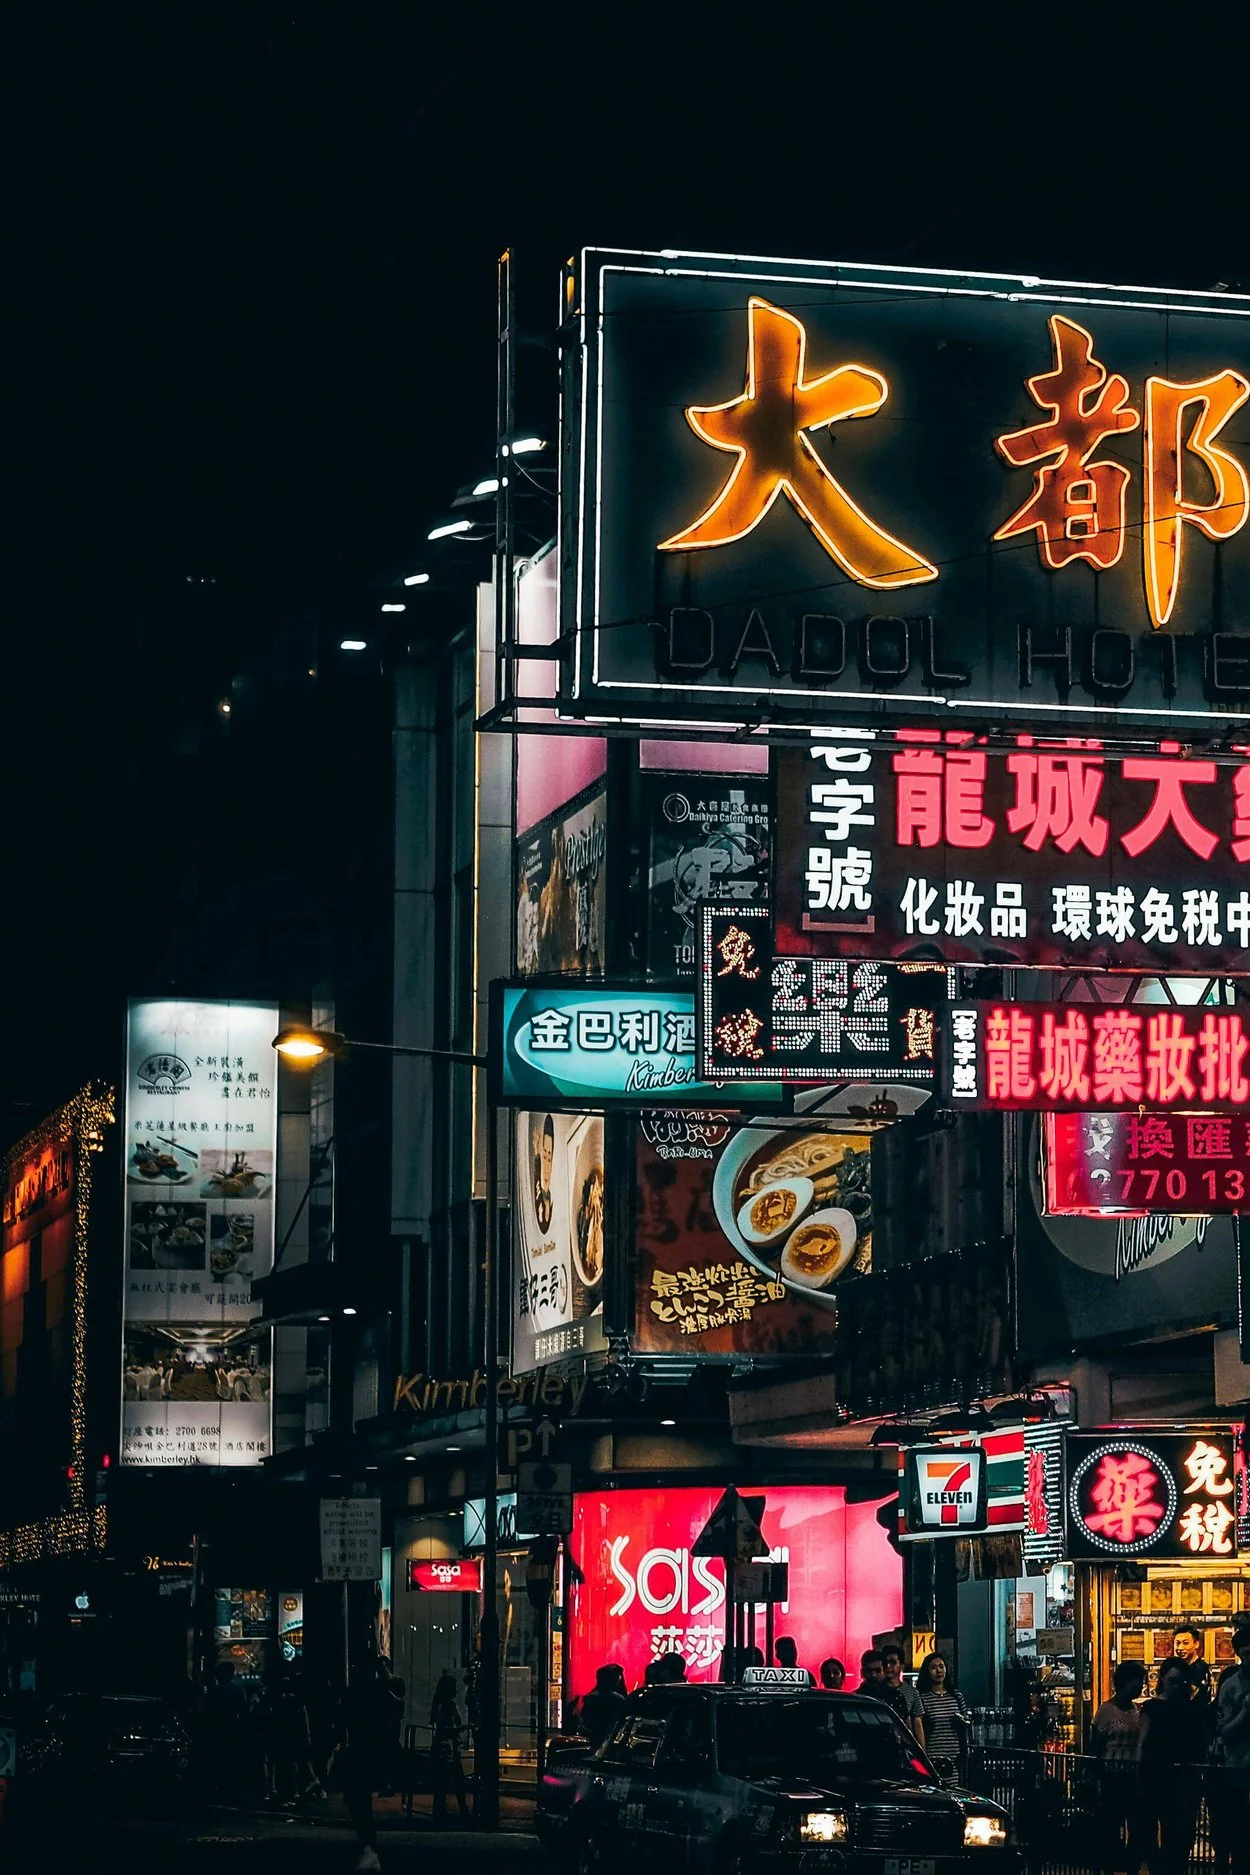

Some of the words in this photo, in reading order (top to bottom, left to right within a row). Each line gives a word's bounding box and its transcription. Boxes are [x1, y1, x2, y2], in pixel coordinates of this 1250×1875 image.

[667, 605, 972, 687] DADOL
[900, 877, 1028, 939] 化妝品
[751, 1668, 806, 1683] TAXI
